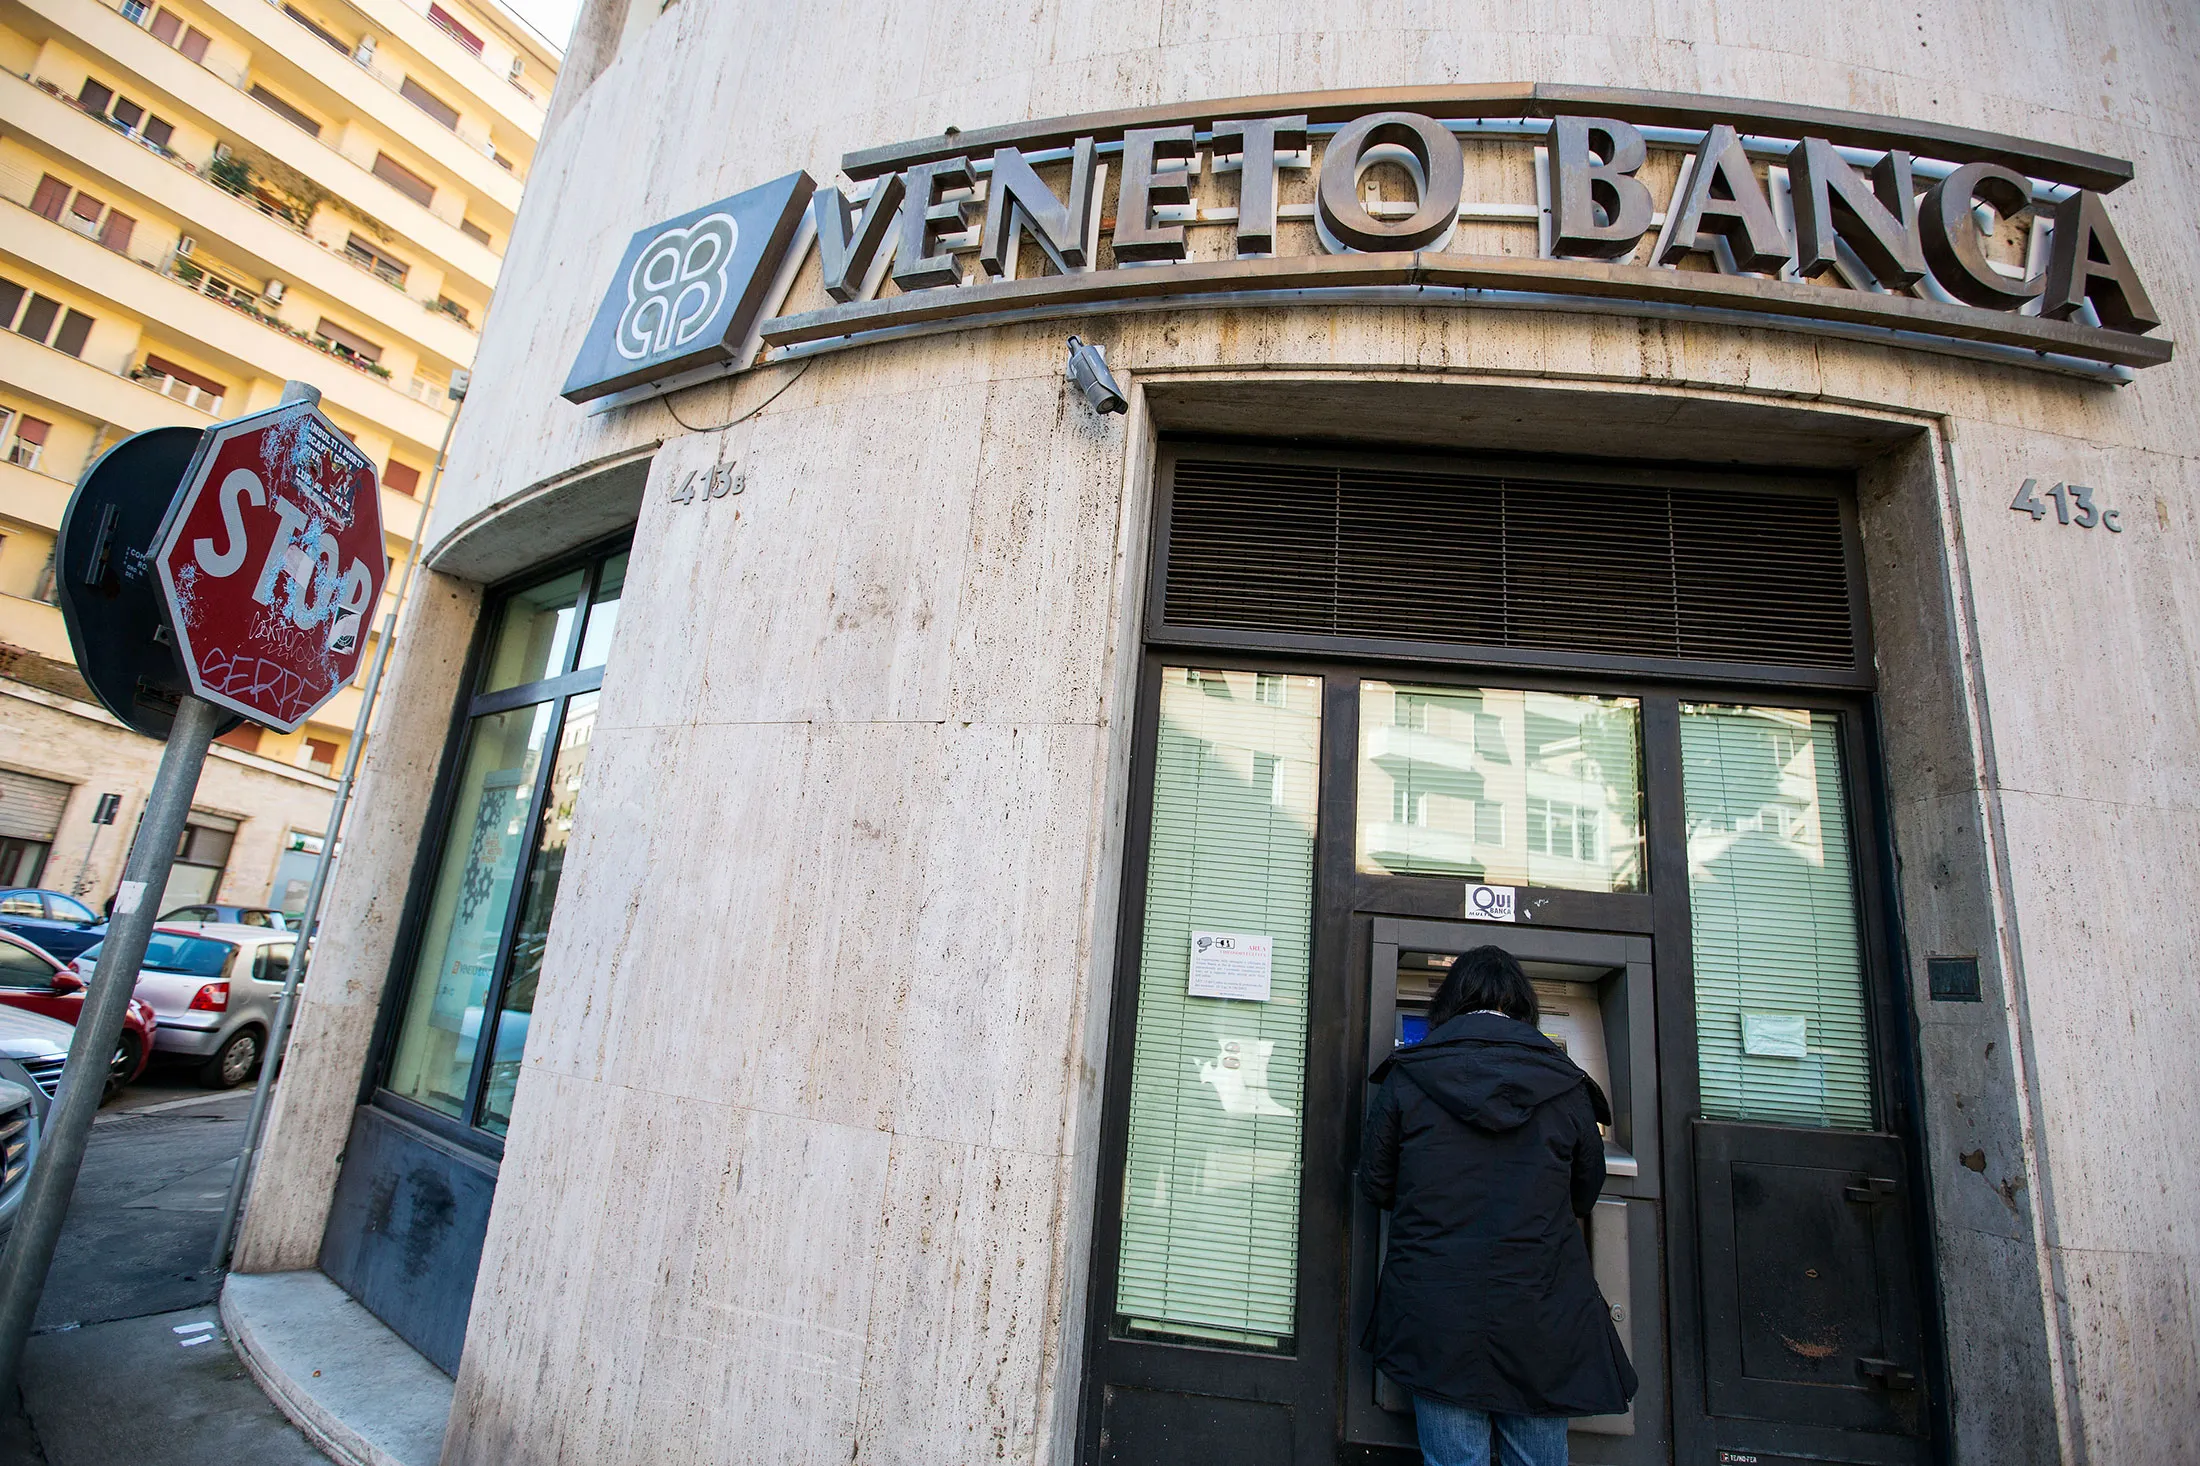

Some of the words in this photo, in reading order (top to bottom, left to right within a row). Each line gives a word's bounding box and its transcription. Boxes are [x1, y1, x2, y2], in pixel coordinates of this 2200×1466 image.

[813, 112, 1464, 302] VENETO
[1546, 115, 2161, 334] BANCA
[671, 461, 745, 505] 413B
[194, 468, 372, 630] STOP
[1473, 887, 1511, 917] QUI
[1490, 907, 1512, 915] BANCA
